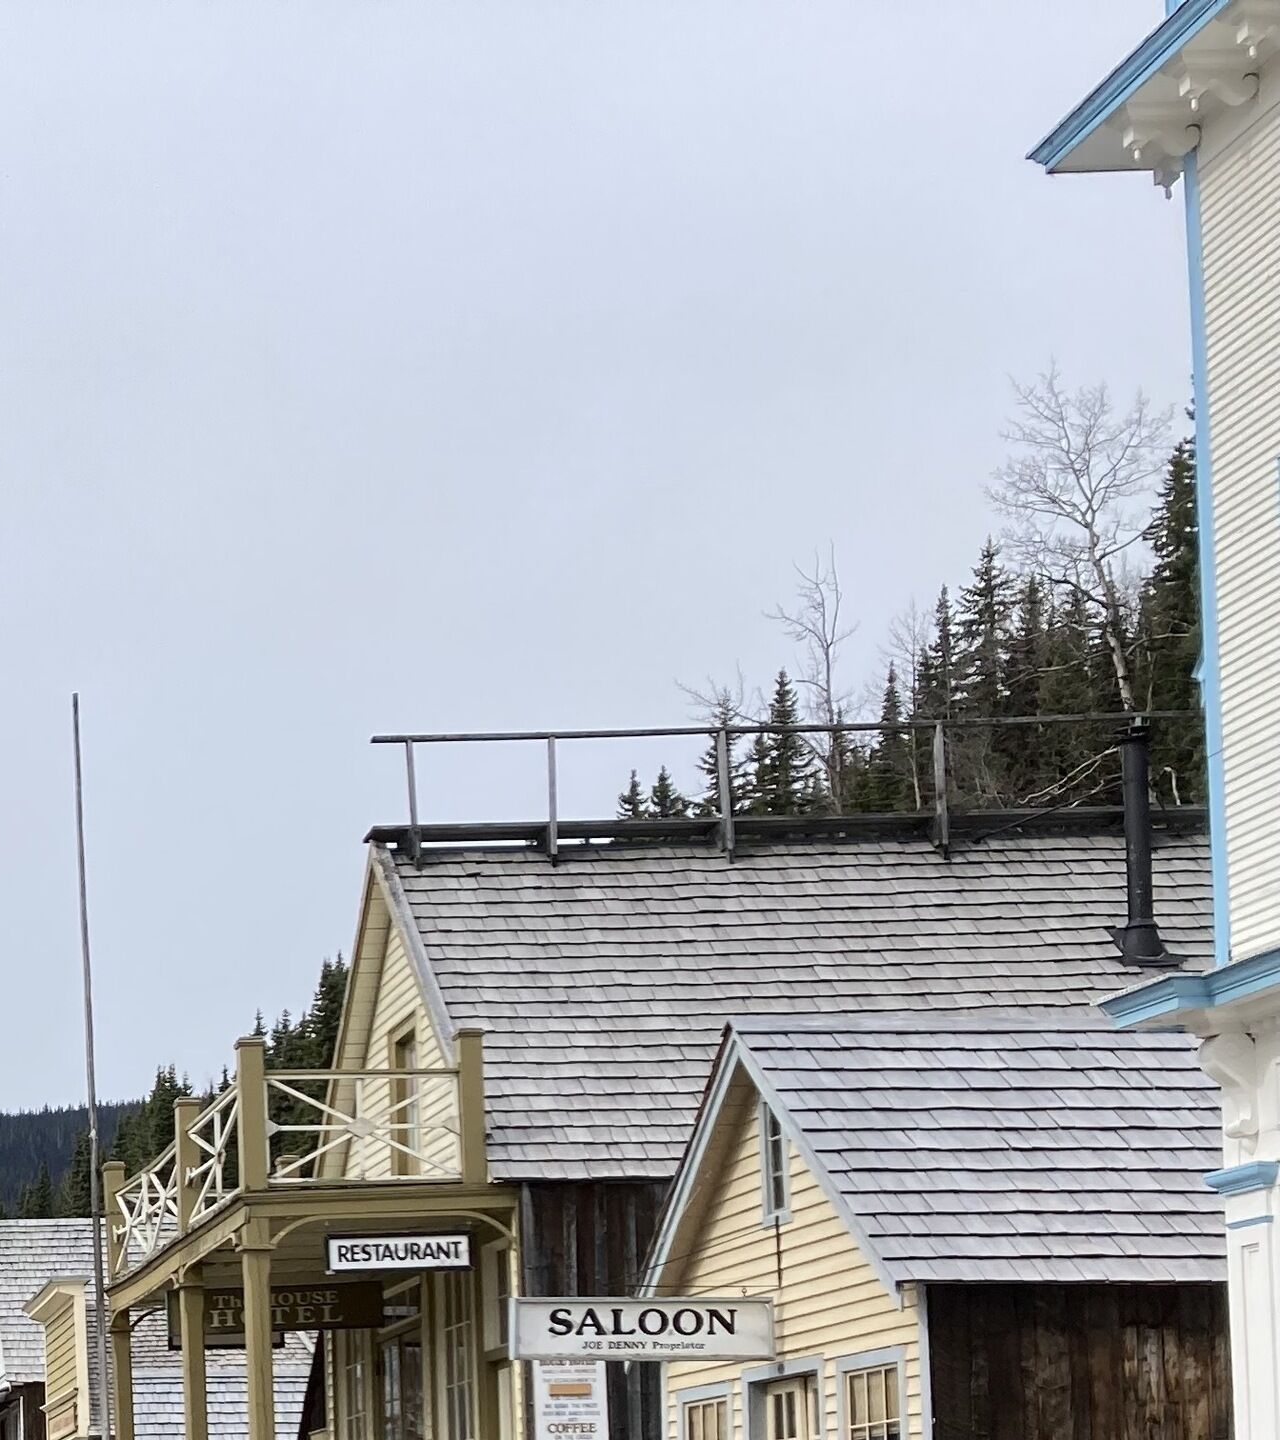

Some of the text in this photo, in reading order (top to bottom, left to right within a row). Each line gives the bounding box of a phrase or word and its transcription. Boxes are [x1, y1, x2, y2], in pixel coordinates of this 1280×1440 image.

[337, 1241, 463, 1262] RESTAURANT
[212, 1294, 243, 1309] Th
[210, 1304, 343, 1328] HTEL
[547, 1307, 738, 1336] SALOON
[581, 1341, 706, 1352] JOE DENNY Proprietor
[547, 1422, 598, 1434] COFFEE
